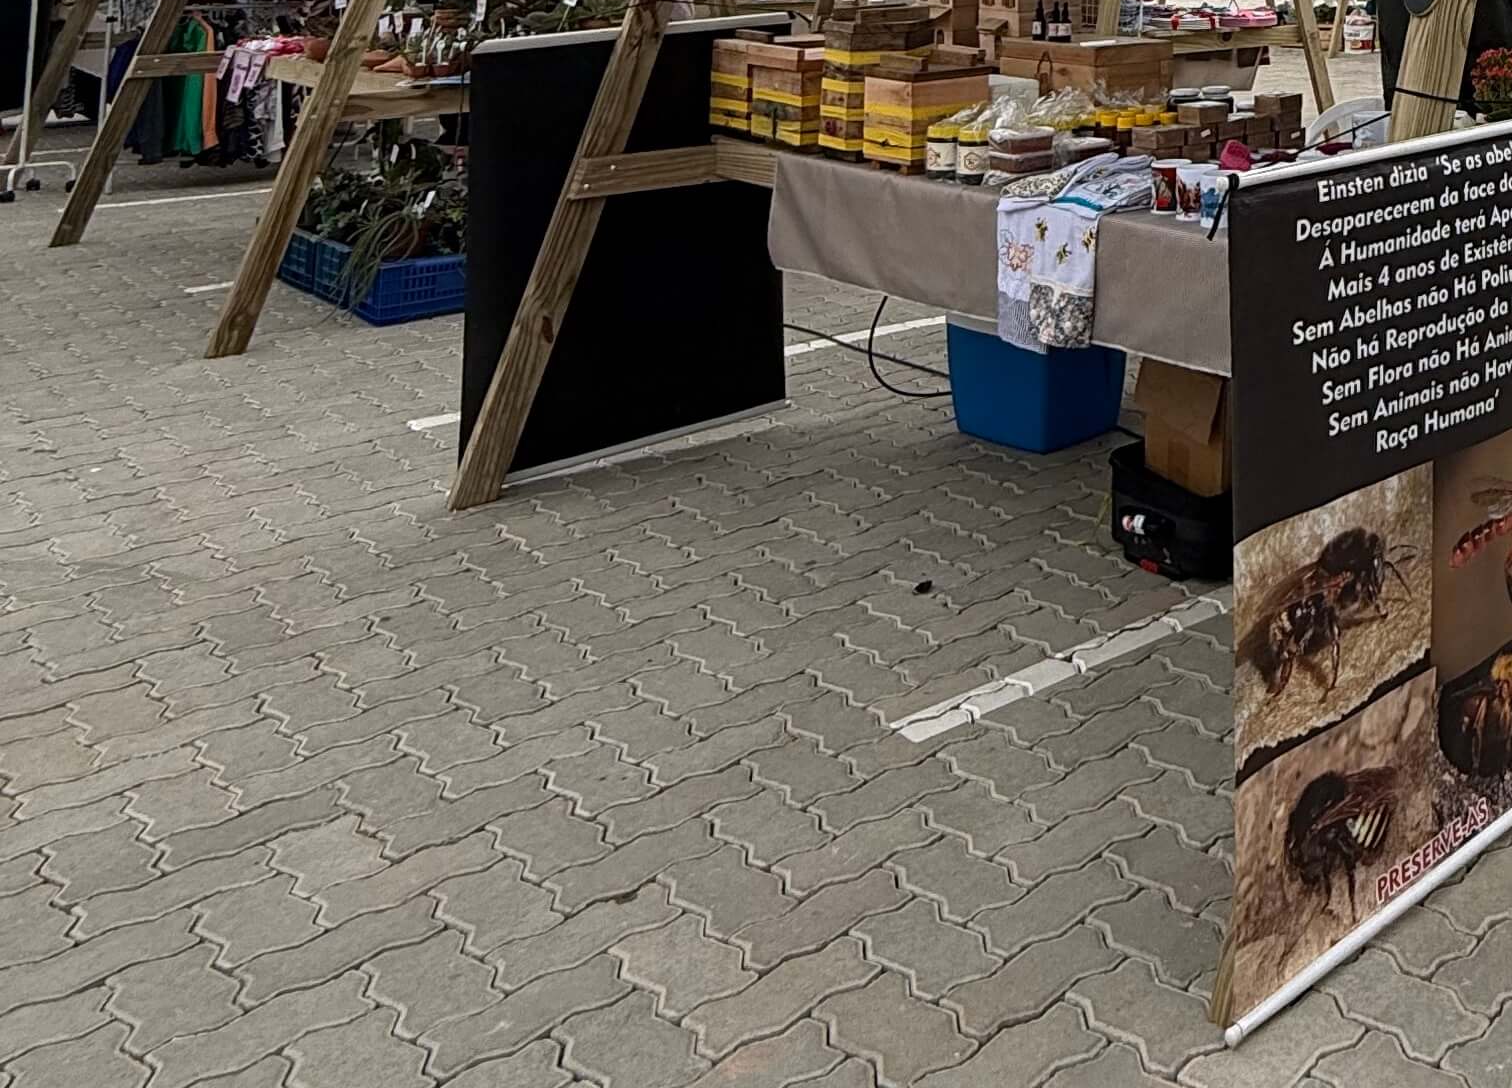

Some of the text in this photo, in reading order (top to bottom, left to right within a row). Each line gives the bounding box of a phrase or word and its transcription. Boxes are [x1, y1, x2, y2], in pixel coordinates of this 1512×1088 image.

[1317, 176, 1384, 202] Einsten
[1389, 162, 1428, 187] dizia
[1465, 154, 1482, 170] as
[1296, 197, 1434, 241] Desaparecerem
[1440, 186, 1458, 207] da
[1463, 181, 1495, 201] face
[1319, 239, 1334, 270] Á
[1341, 220, 1450, 264] Humanidade
[1455, 209, 1485, 234] terá
[1328, 273, 1372, 301] Mais
[1378, 265, 1390, 286] 4
[1395, 260, 1435, 283] anos
[1440, 249, 1459, 271] de
[1293, 320, 1333, 345] Sem
[1339, 298, 1411, 331] Abelhas
[1417, 286, 1448, 309] não
[1454, 274, 1476, 298] Há
[1312, 347, 1351, 373] Não
[1357, 334, 1379, 359] há
[1386, 307, 1485, 350] Reprodução
[1490, 297, 1508, 319] da
[1322, 379, 1361, 404] Sem
[1368, 363, 1412, 389] Flora
[1419, 349, 1450, 372] não
[1457, 336, 1479, 360] Há
[1329, 410, 1368, 436] Sem
[1373, 381, 1444, 420] Animais
[1449, 371, 1479, 394] não
[1376, 424, 1418, 452] Raça
[1376, 797, 1489, 904] PRESERVE-AS
